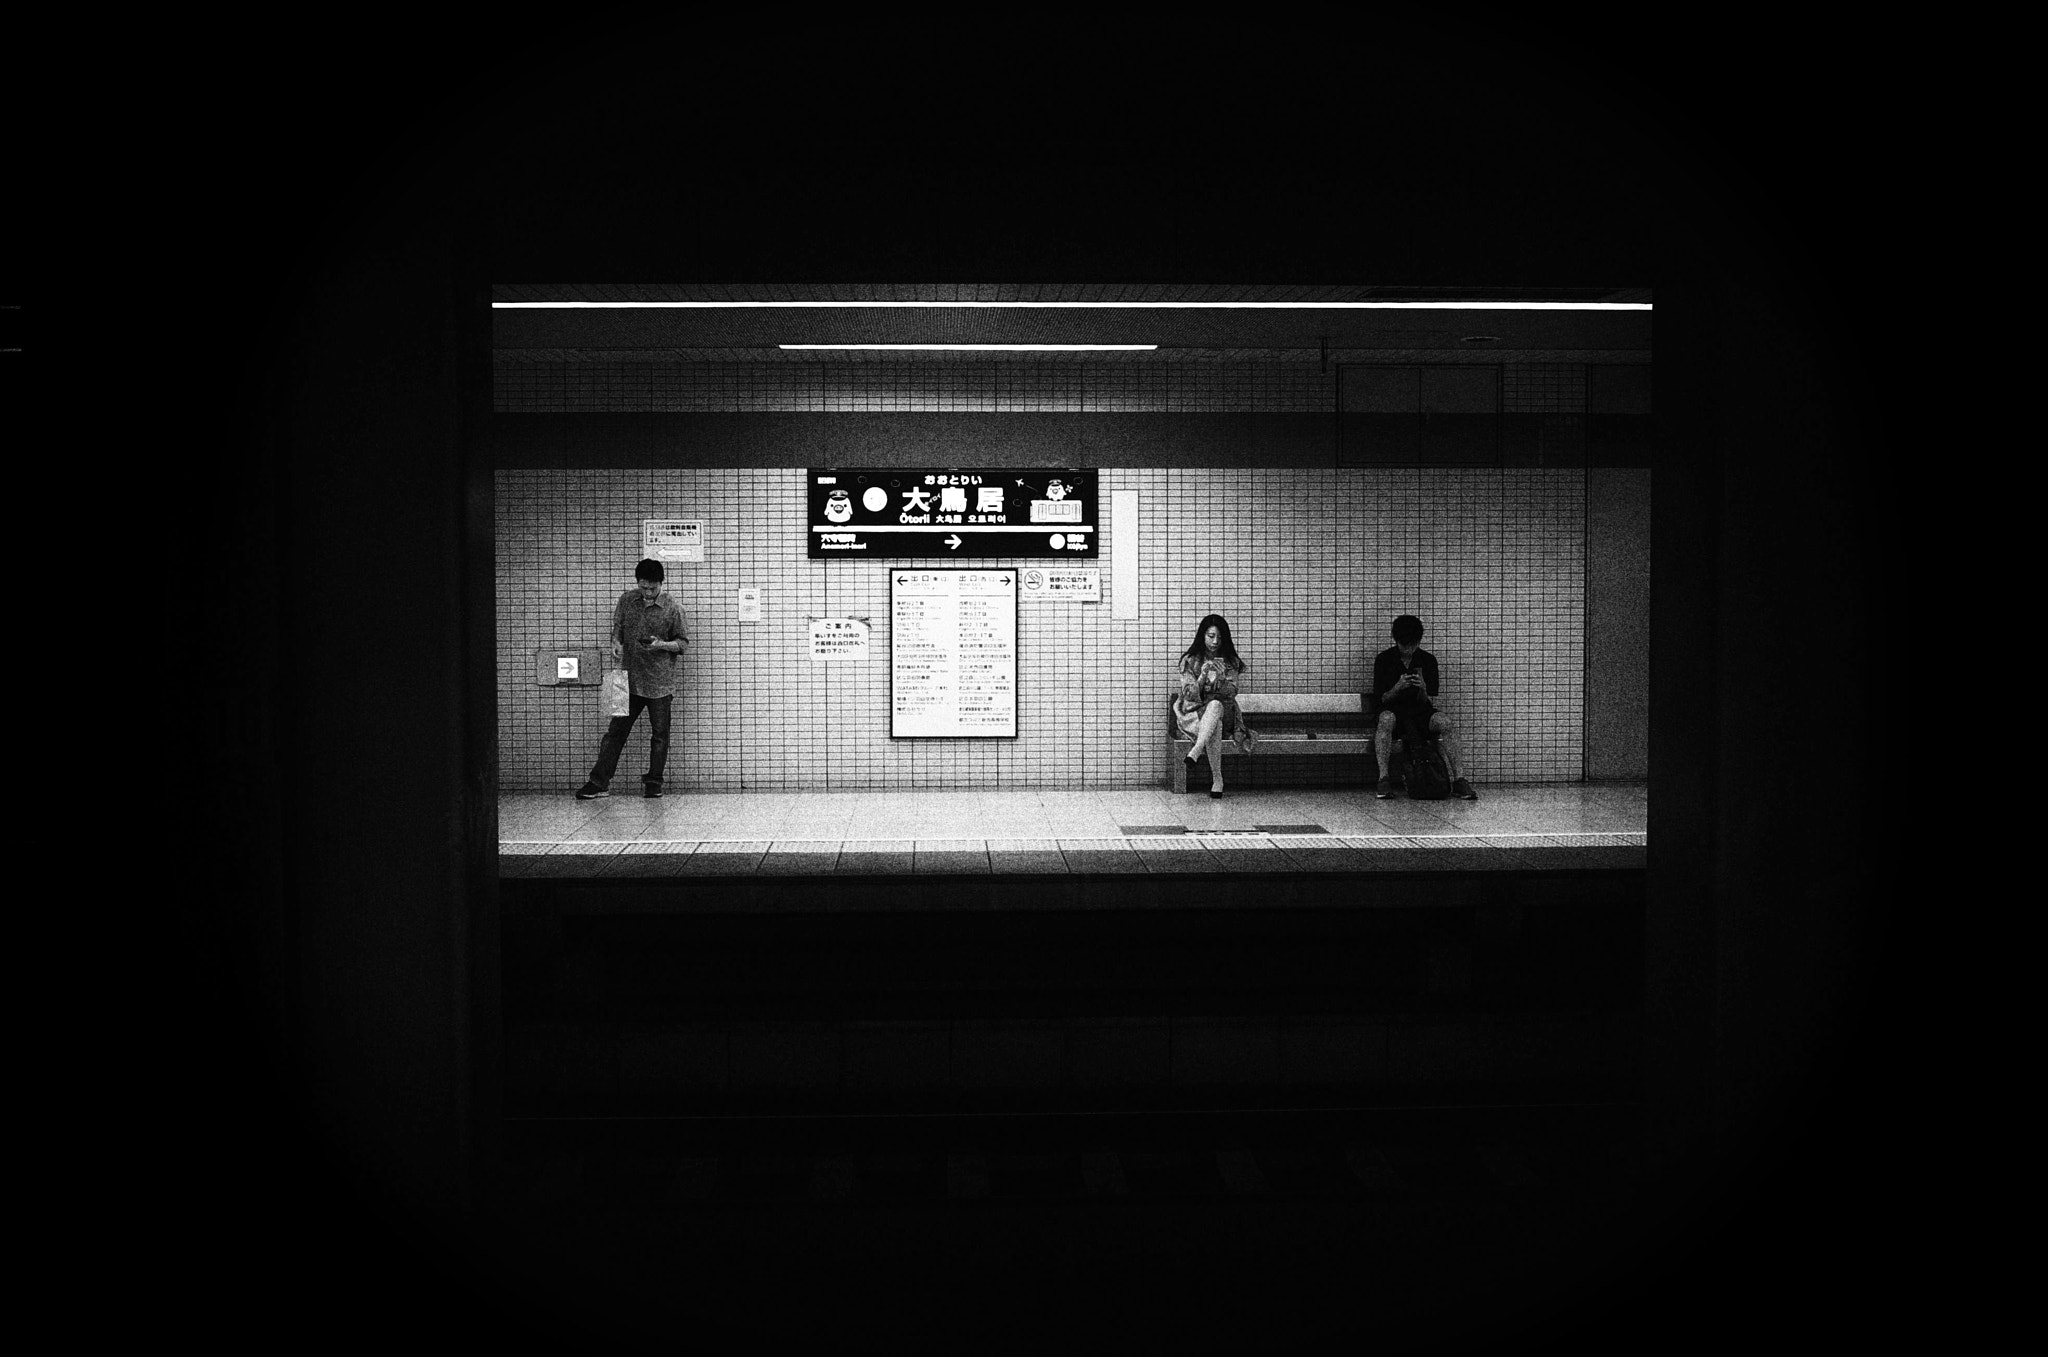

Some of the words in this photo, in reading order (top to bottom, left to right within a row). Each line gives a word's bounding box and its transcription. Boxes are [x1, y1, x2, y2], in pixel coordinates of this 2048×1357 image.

[924, 475, 983, 485] おおとりい
[902, 486, 1005, 512] 大鳥居
